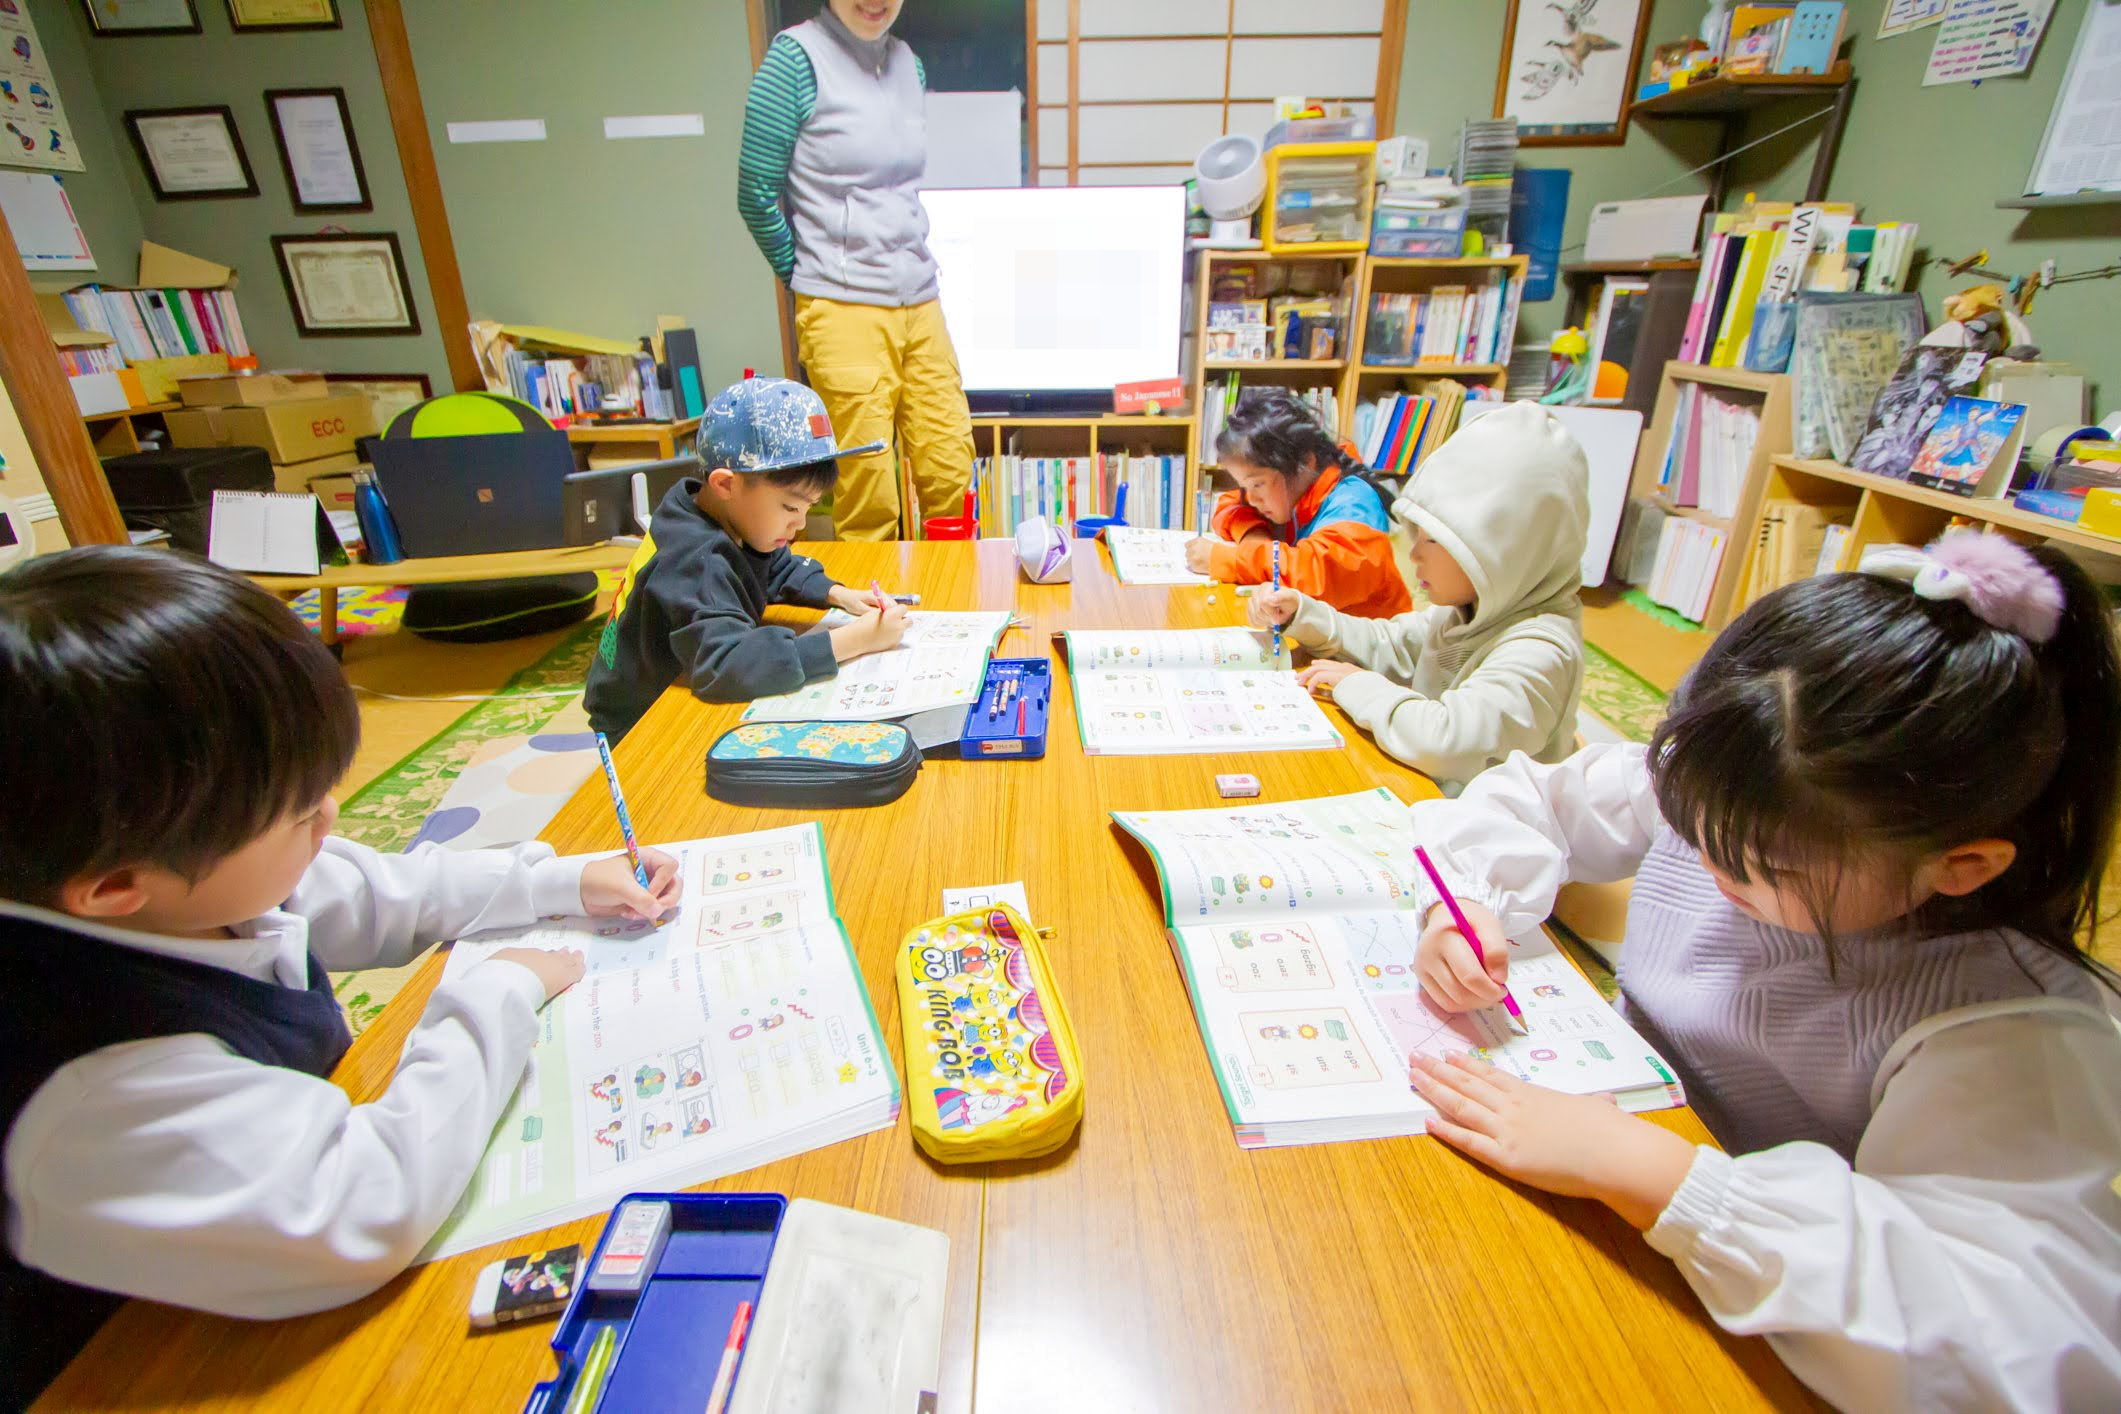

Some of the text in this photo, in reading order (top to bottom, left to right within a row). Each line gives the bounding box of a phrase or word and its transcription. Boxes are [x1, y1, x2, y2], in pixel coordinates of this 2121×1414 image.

[311, 418, 345, 438] ECC
[1250, 961, 1261, 979] zoo
[1276, 958, 1289, 977] zero
[1300, 948, 1317, 977] zigzag
[927, 989, 966, 1080] KING BOB
[856, 1033, 878, 1077] Unit 6-3
[1315, 1055, 1329, 1073] sun
[1344, 1050, 1360, 1070] sofa
